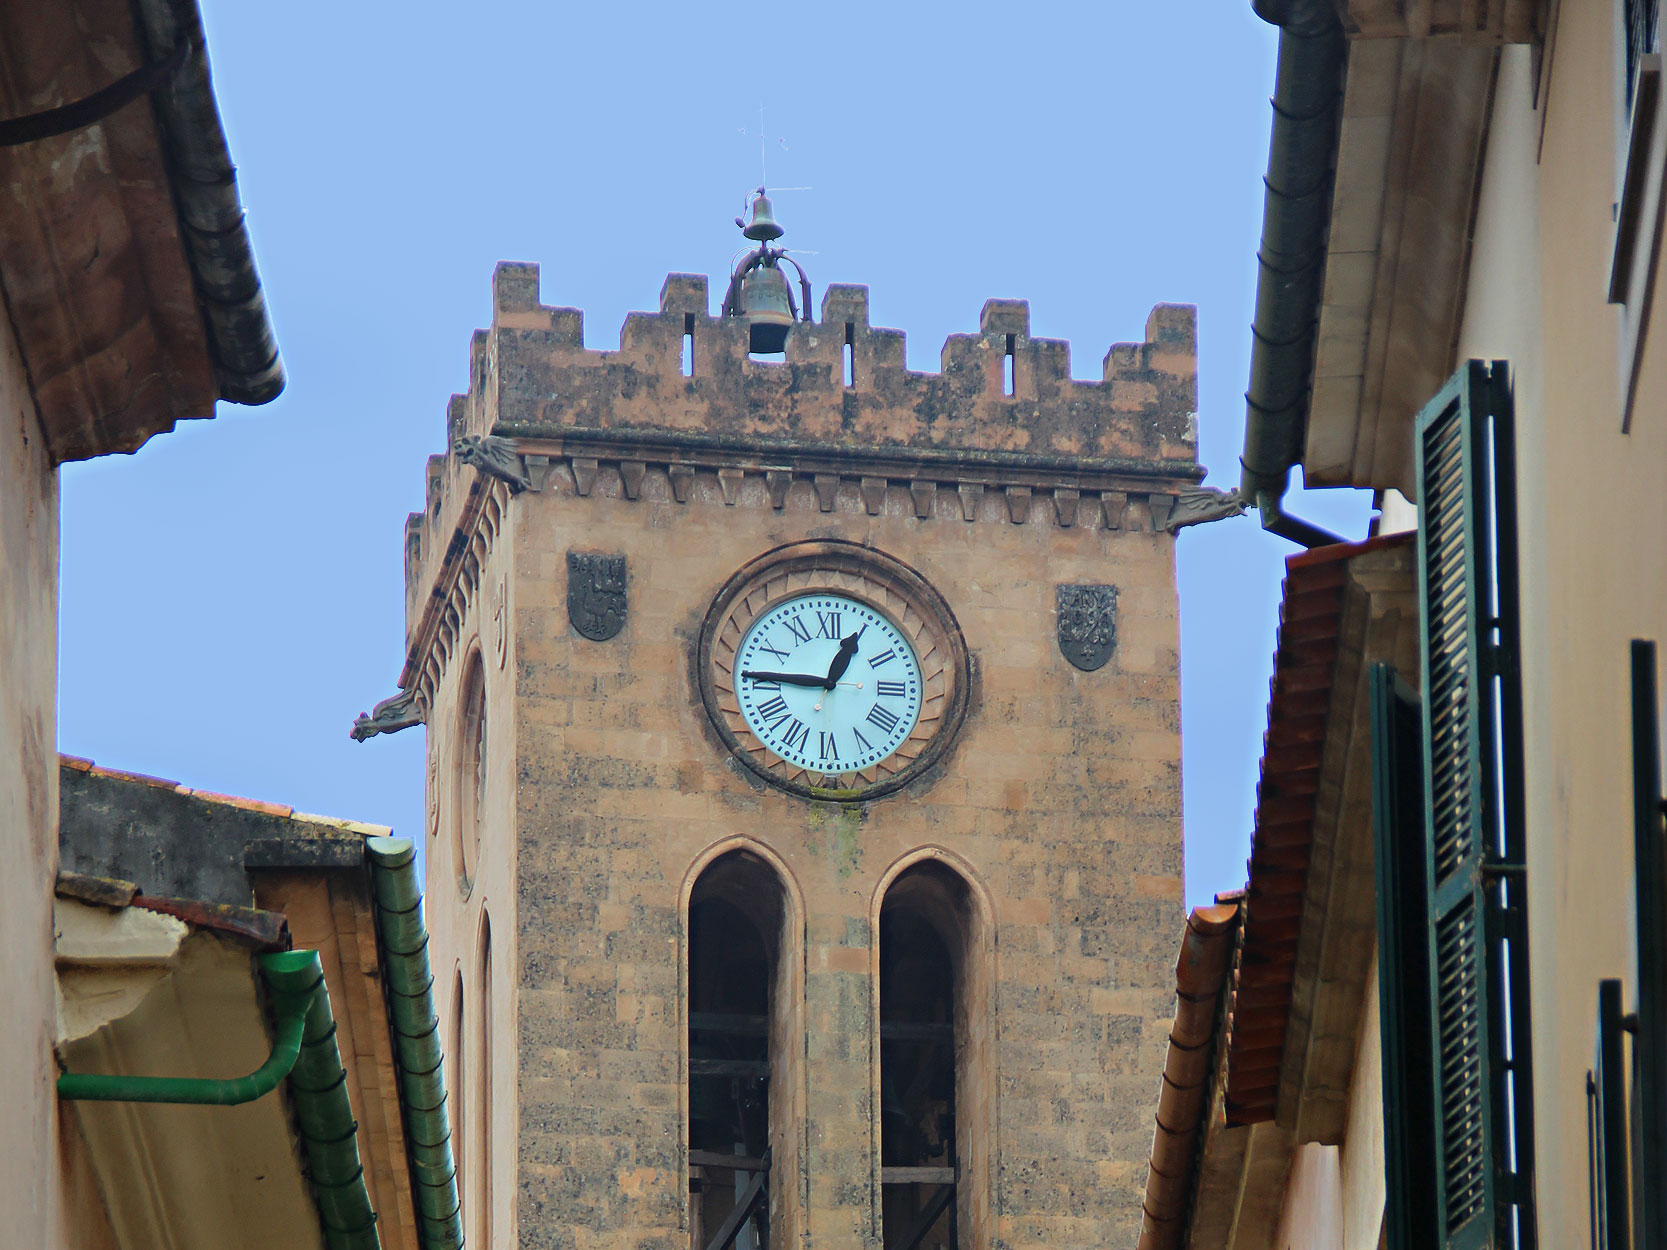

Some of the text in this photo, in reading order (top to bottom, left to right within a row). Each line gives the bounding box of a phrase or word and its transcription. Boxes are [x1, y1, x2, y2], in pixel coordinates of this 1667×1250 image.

[782, 614, 813, 647] XI
[815, 610, 842, 640] XII
[759, 638, 790, 665] X
[867, 648, 898, 669] II
[877, 680, 906, 698] III
[756, 694, 793, 733] VIII
[866, 703, 900, 735] IIII
[780, 717, 811, 754] VII
[819, 731, 841, 760] VI
[852, 726, 874, 755] V
